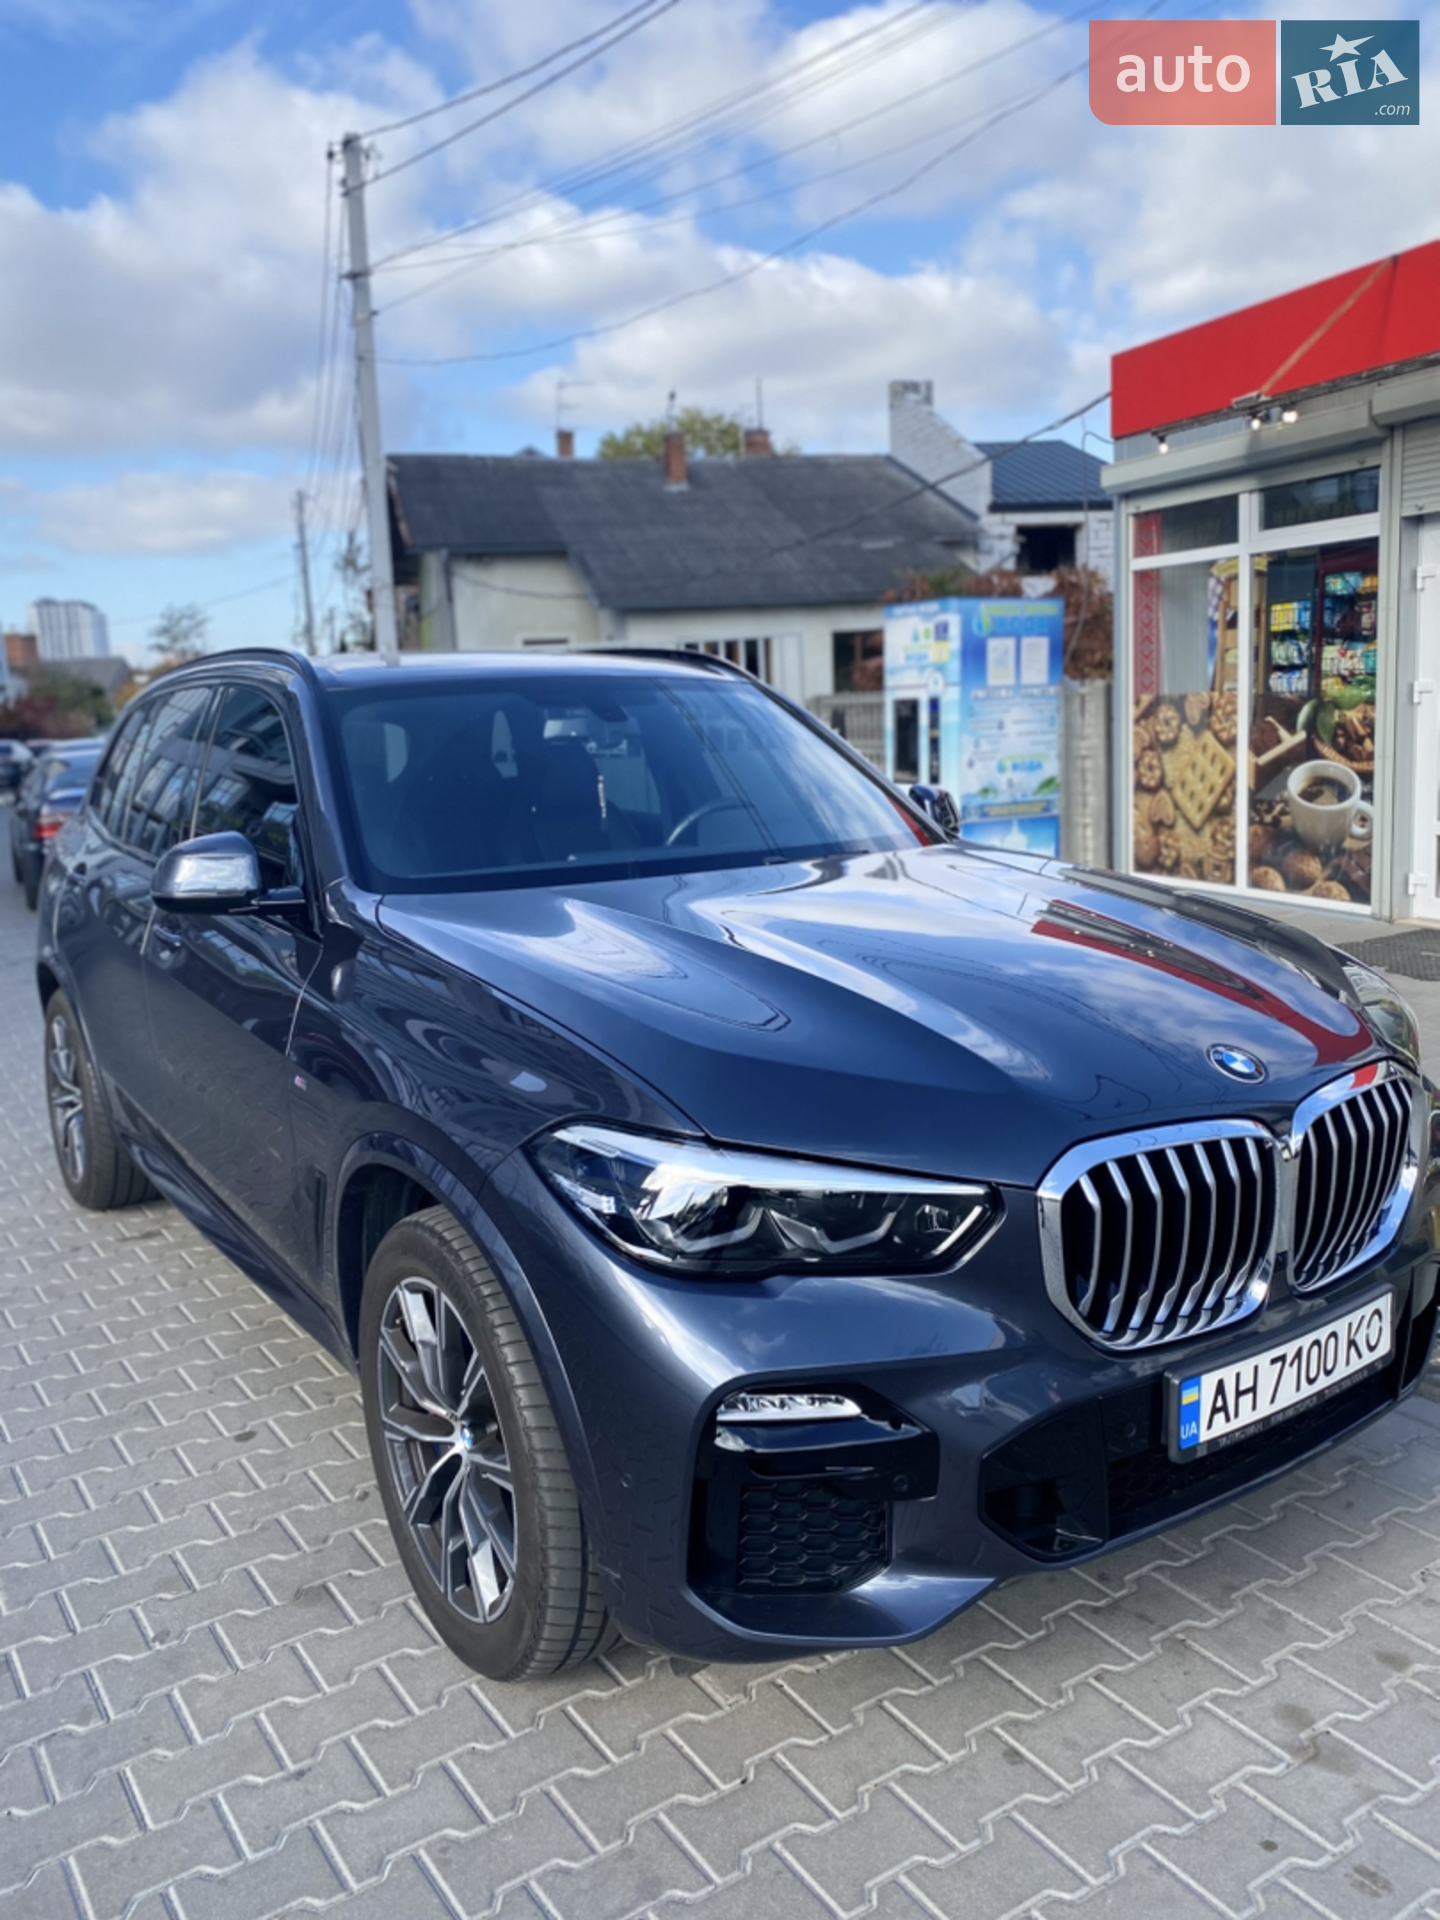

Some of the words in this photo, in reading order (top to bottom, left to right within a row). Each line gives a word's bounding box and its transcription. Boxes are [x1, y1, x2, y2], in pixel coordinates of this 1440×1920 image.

[1206, 1364, 1260, 1432] AH
[1268, 1330, 1340, 1406] 7100
[1344, 1307, 1384, 1368] KO
[1180, 1420, 1198, 1440] UA
